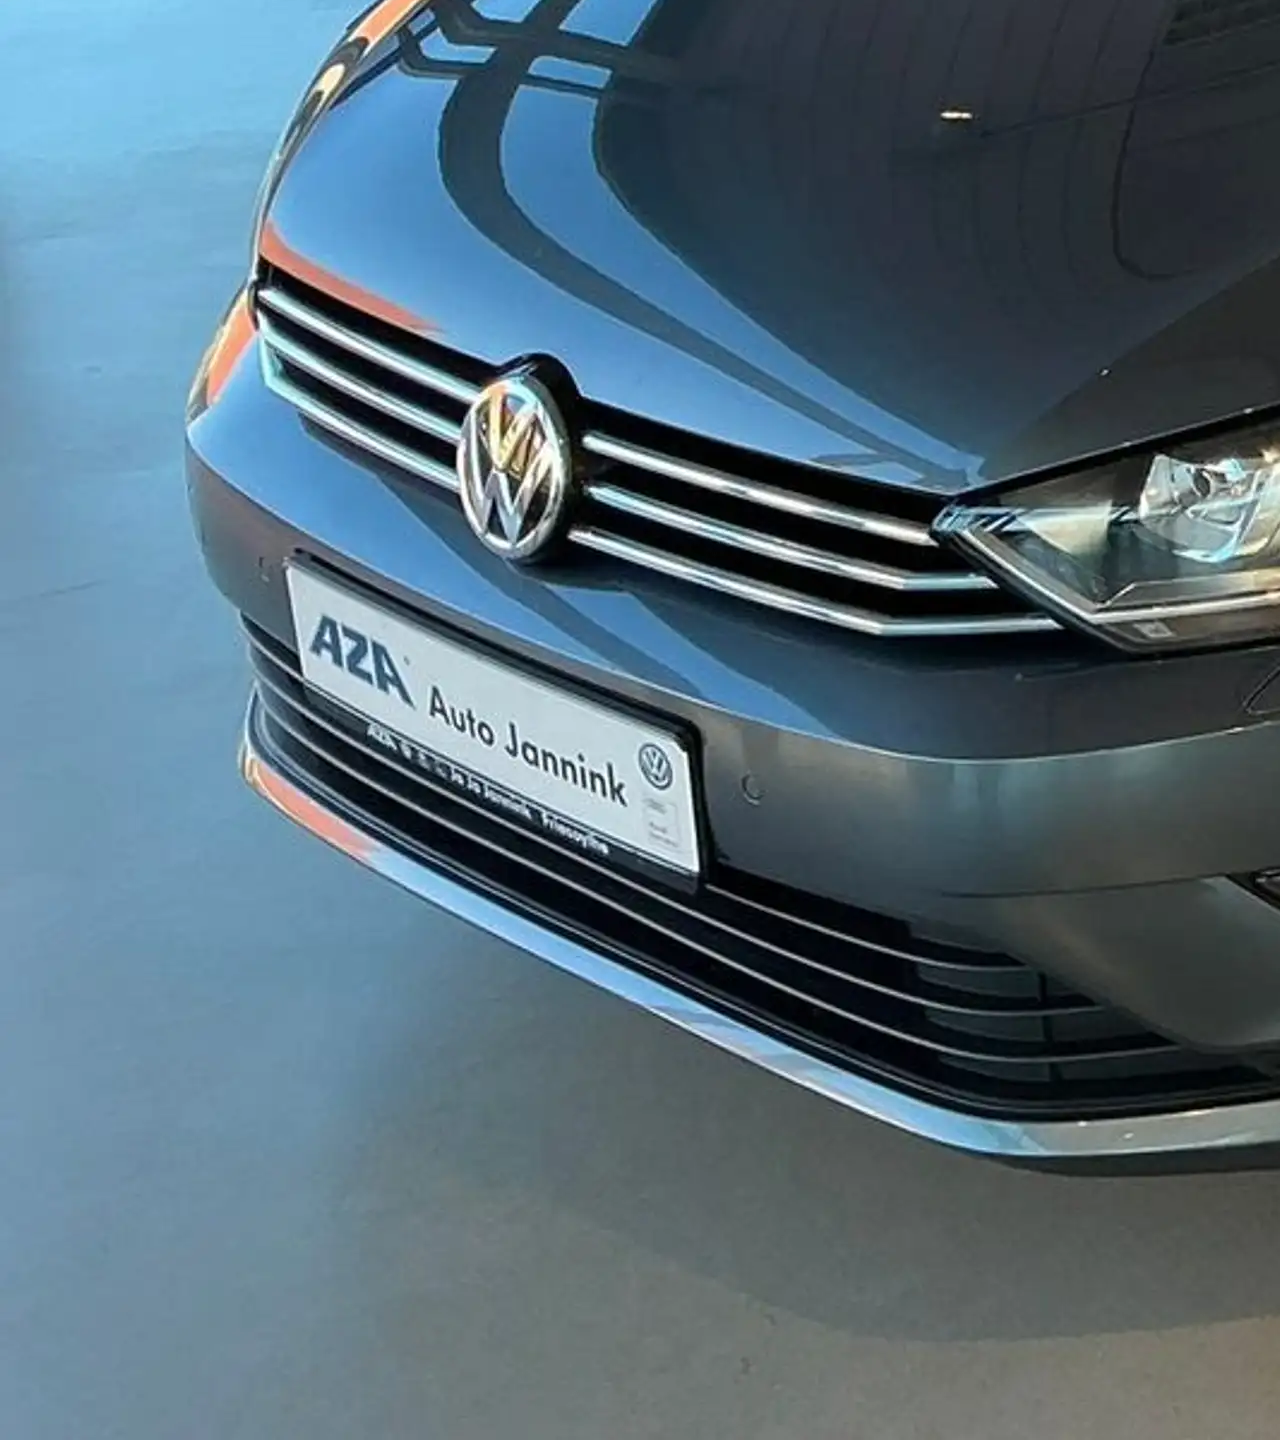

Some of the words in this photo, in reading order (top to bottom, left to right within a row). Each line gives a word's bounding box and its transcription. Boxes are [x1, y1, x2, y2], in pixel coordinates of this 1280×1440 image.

[310, 614, 416, 710] AZA
[428, 685, 496, 748] Auto
[504, 721, 629, 808] Jannink
